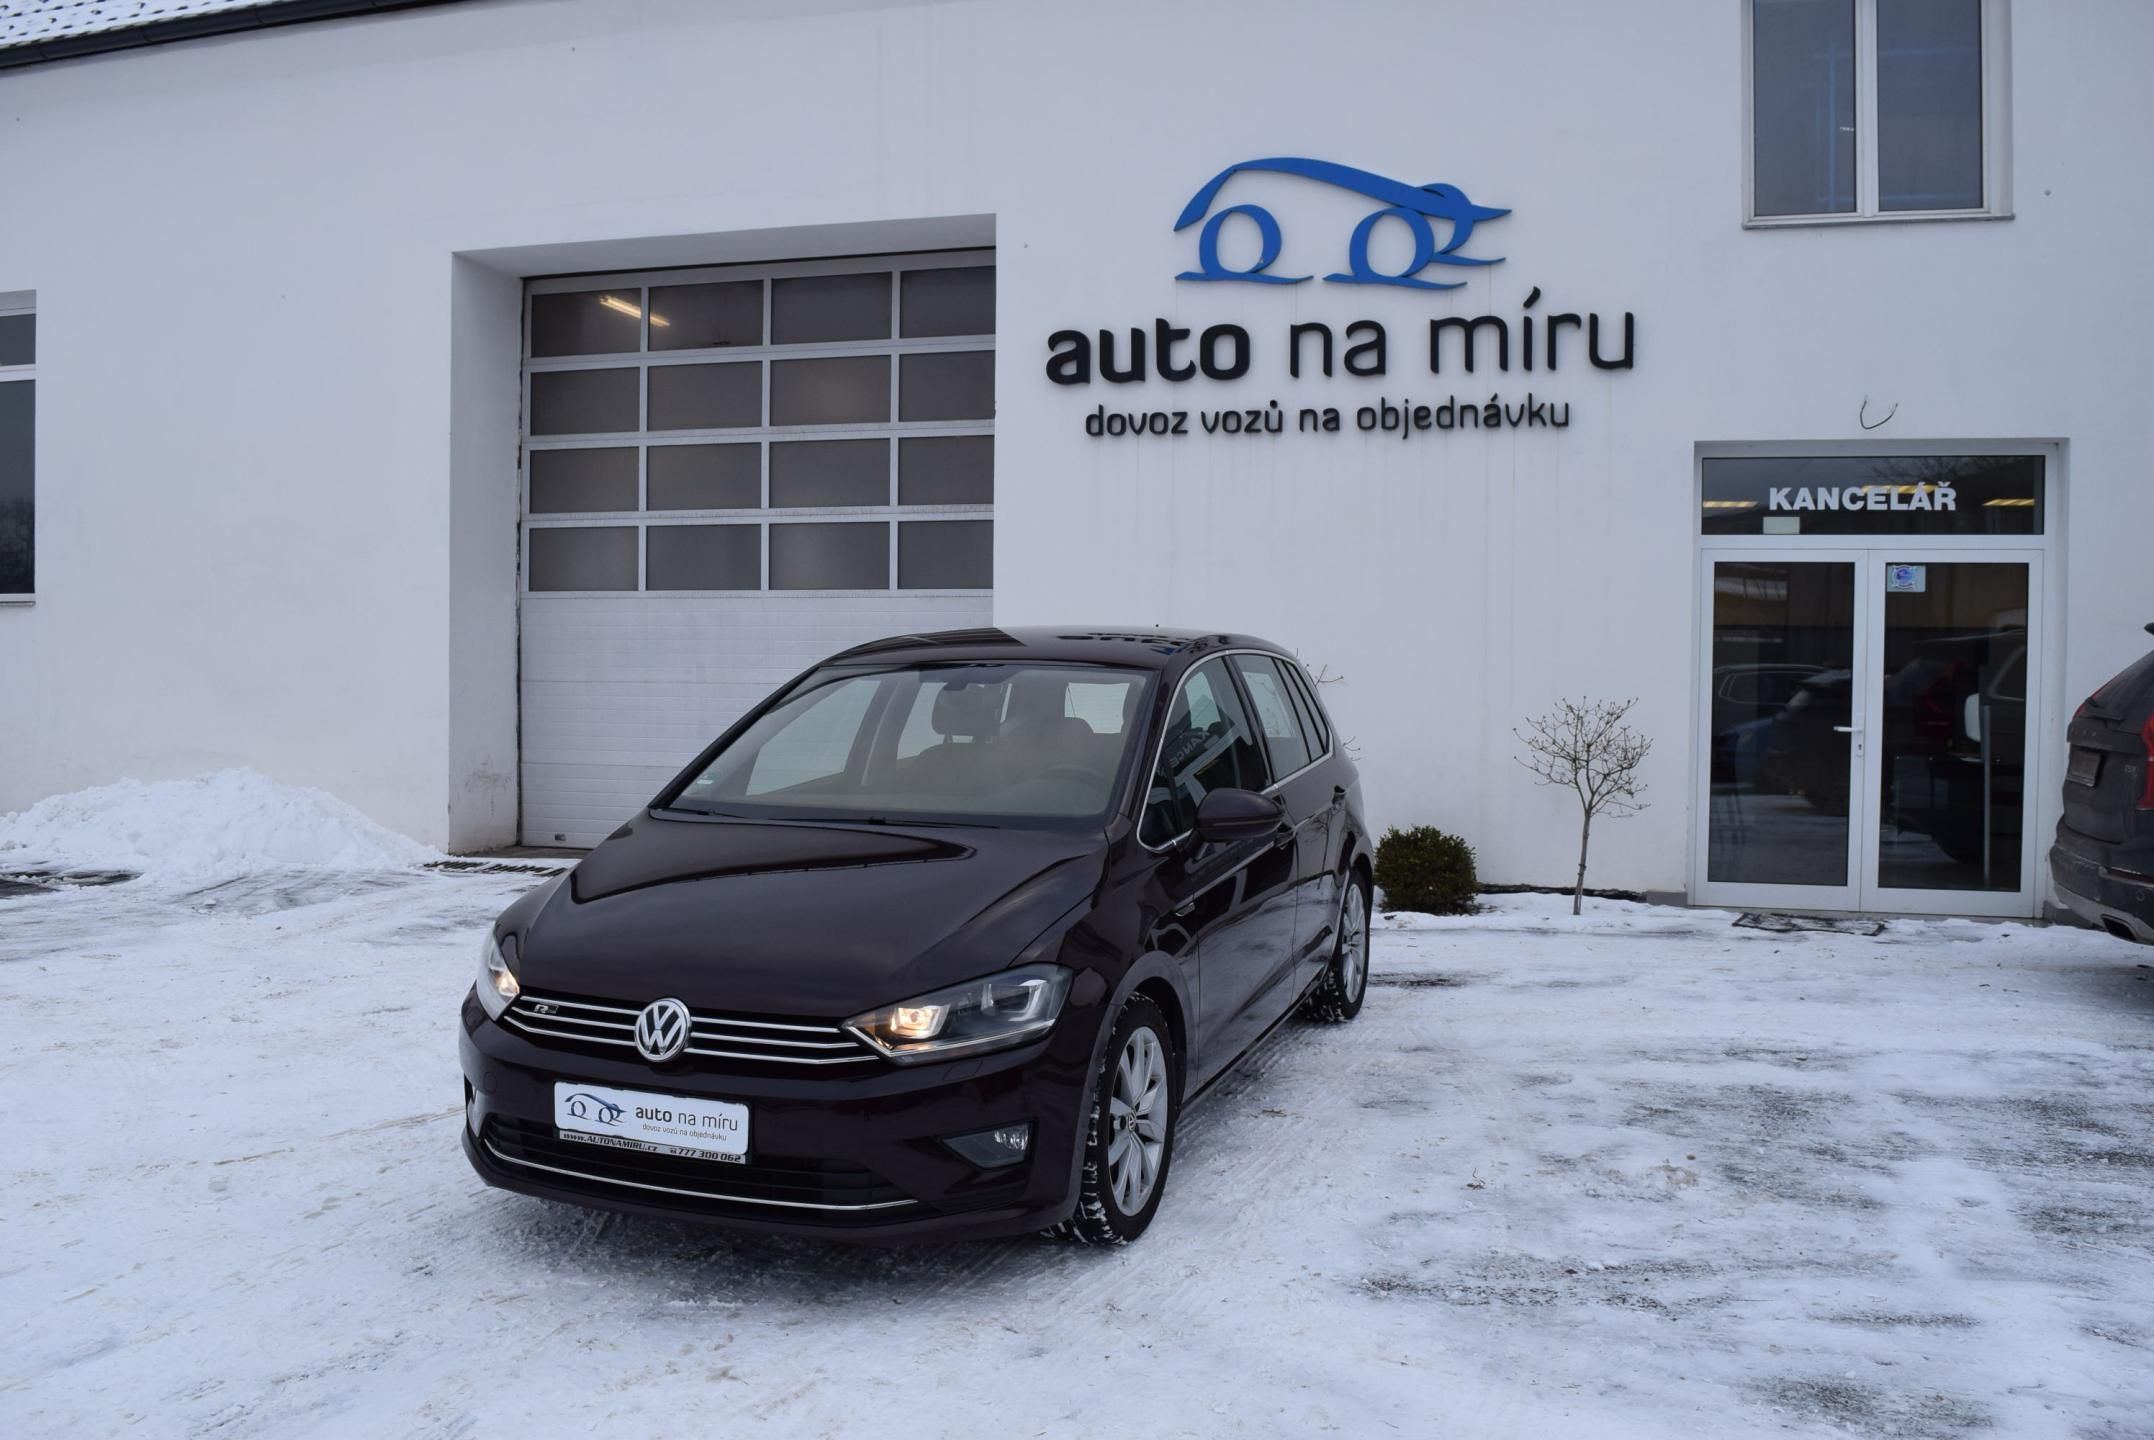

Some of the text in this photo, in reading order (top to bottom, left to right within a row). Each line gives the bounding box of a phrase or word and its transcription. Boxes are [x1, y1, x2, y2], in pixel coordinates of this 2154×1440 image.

[1045, 286, 1635, 385] auto na míru
[1085, 393, 1570, 440] dovoz vozů na objednávku
[1769, 481, 1957, 512] KANCELÁŘ
[635, 1106, 738, 1131] auto na míru
[642, 1122, 661, 1132] dovoz
[689, 1130, 727, 1142] objednávku
[678, 1147, 697, 1157] 777
[698, 1150, 719, 1160] 300
[720, 1153, 741, 1163] 062
